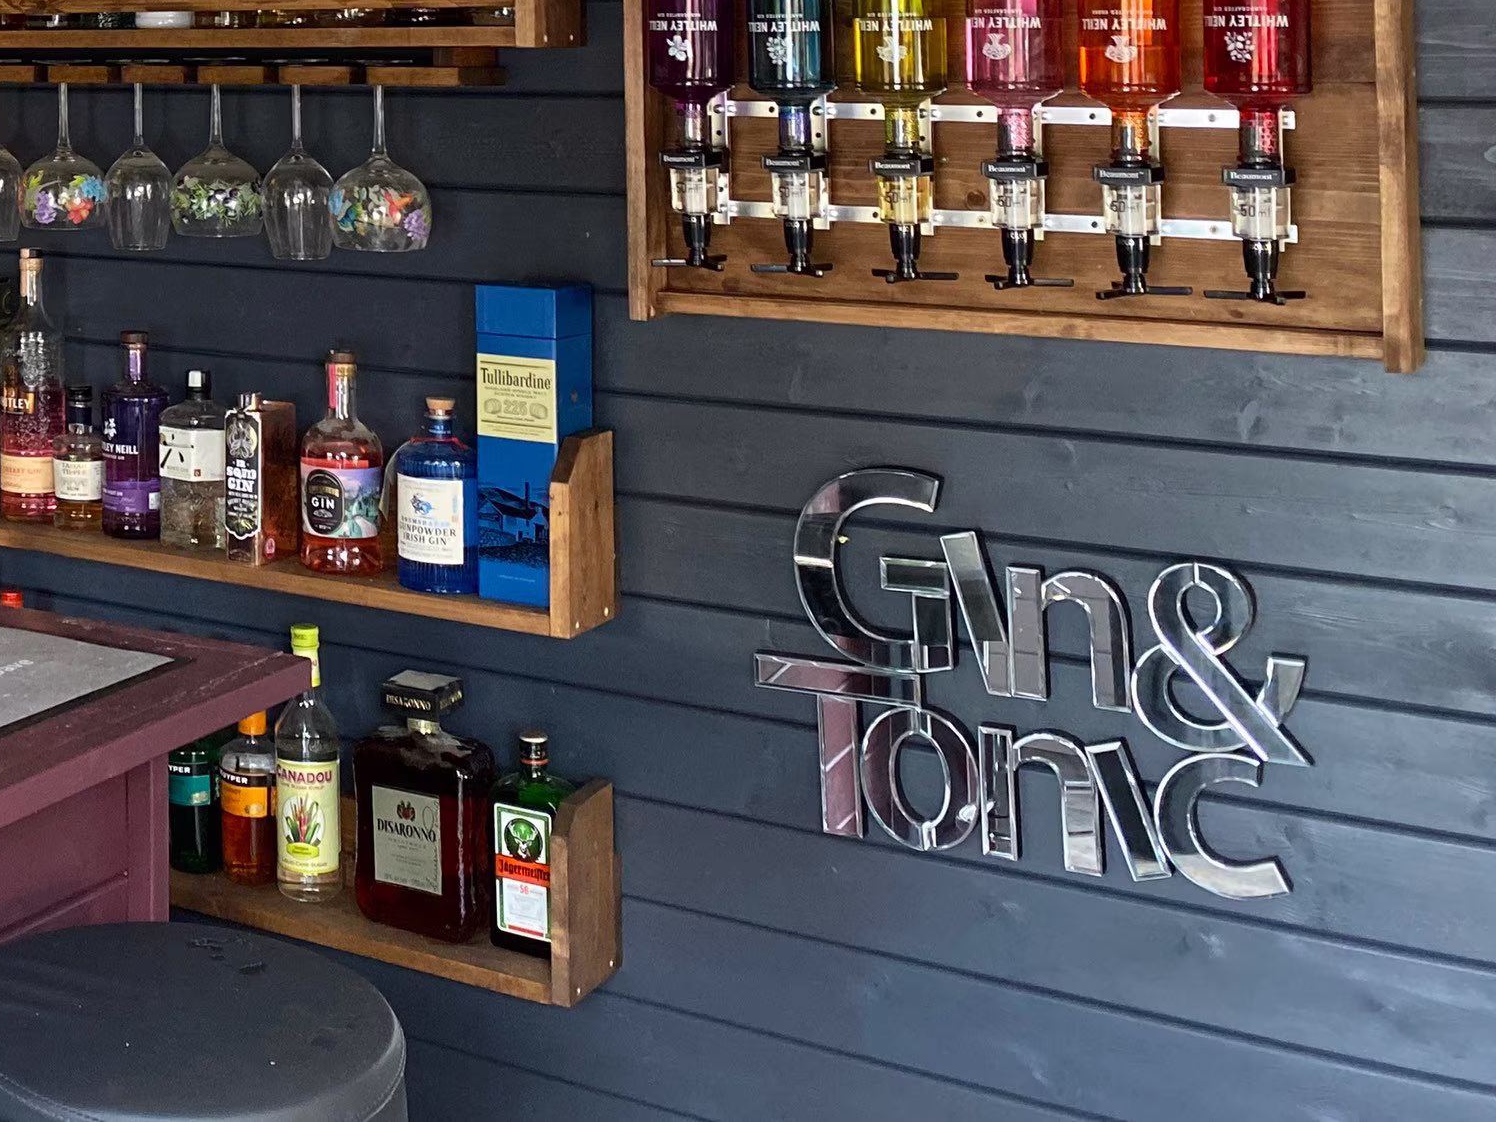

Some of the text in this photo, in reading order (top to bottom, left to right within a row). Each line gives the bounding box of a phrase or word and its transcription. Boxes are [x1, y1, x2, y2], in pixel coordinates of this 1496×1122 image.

[670, 21, 718, 31] WHITLEY
[769, 21, 821, 32] WHITLEY
[988, 16, 1042, 29] WHITLEY
[1082, 18, 1167, 31] WHITLEY NEILL
[1229, 15, 1289, 28] WHITLEY
[480, 367, 551, 390] Tullibardine
[115, 444, 139, 455] NEILL
[227, 477, 254, 493] GIN
[311, 496, 335, 509] GIN
[403, 532, 447, 546] IRISH GIN
[276, 764, 332, 783] CANADOU
[377, 818, 437, 843] DISARONNO
